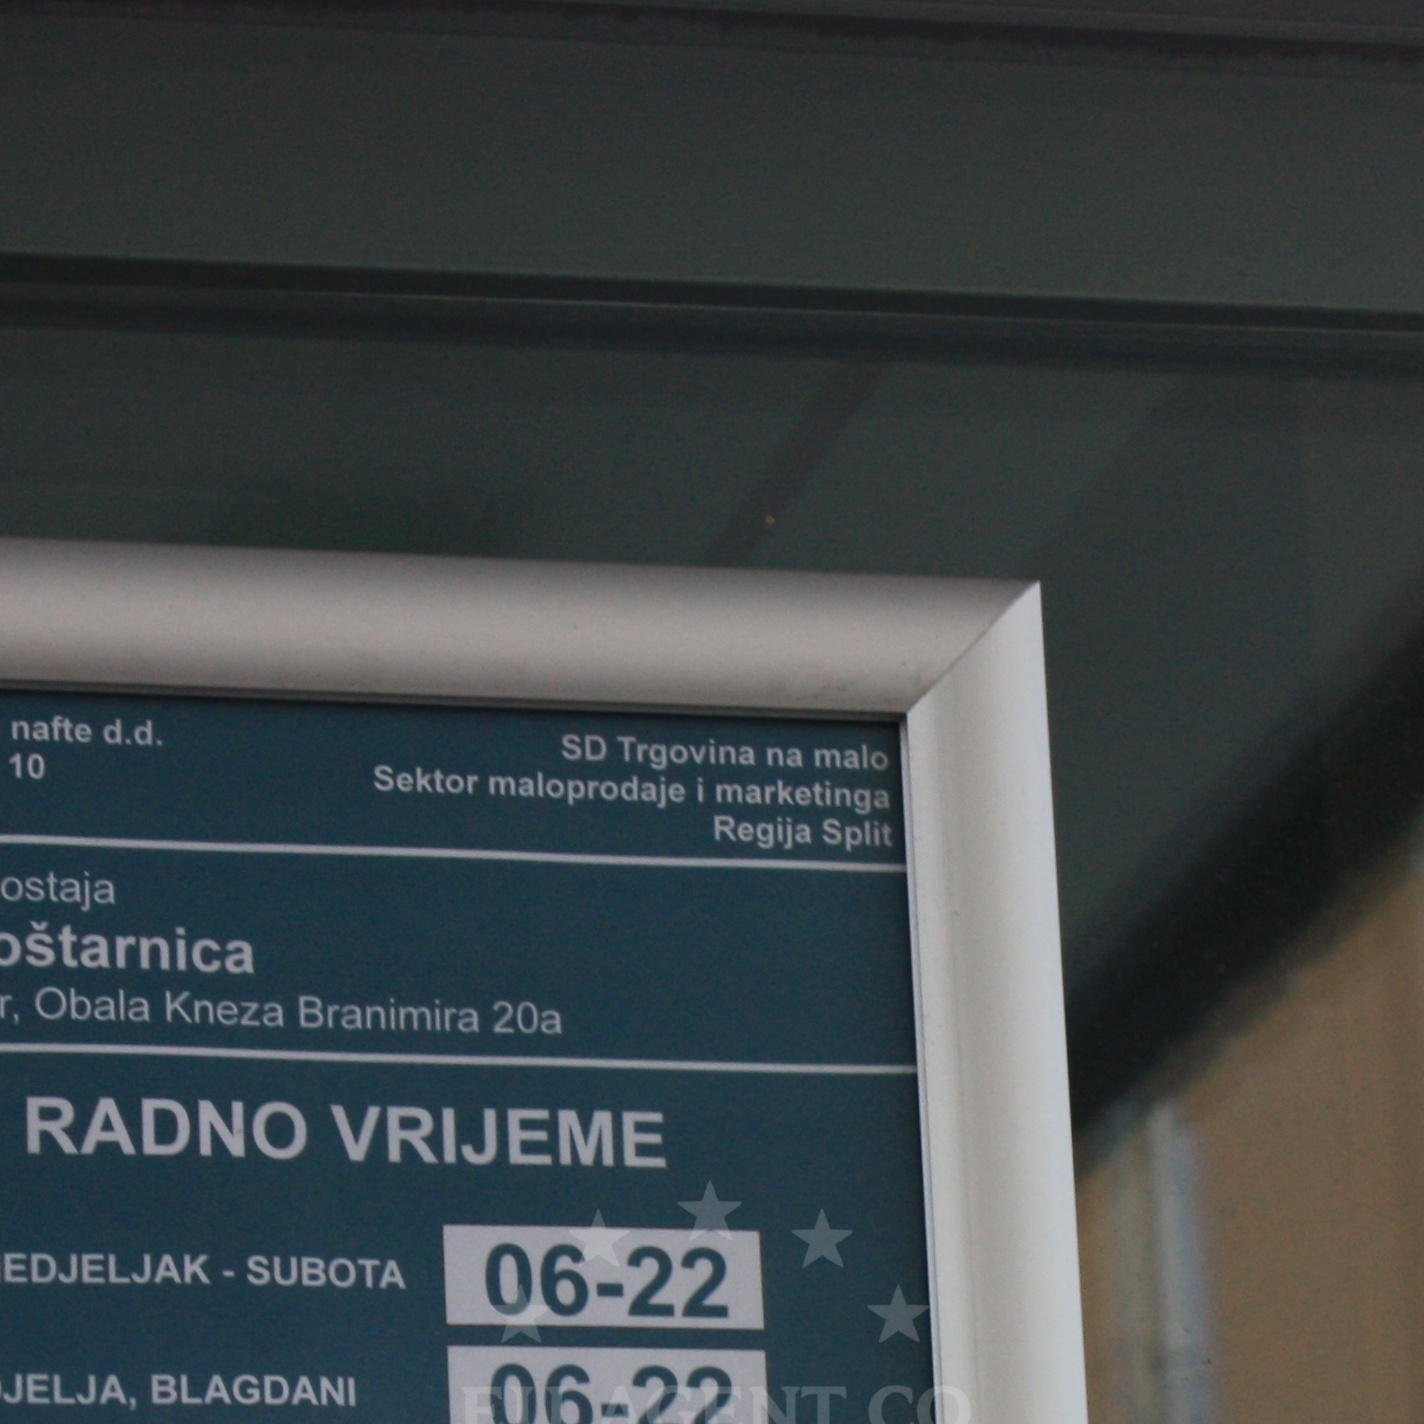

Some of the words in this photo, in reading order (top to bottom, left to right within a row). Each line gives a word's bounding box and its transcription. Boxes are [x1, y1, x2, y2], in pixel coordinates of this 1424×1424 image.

[11, 715, 92, 742] nafte
[103, 720, 163, 746] d.d.
[10, 753, 46, 779] 10
[561, 734, 607, 762] SD
[617, 735, 755, 769] Trgovina
[766, 745, 804, 768] na
[814, 743, 888, 770] malo
[373, 766, 479, 794] Sektor
[488, 772, 686, 808] maloprodaje
[696, 777, 705, 801] i
[715, 778, 891, 812] marketinga
[713, 816, 812, 849] Regija
[822, 819, 894, 850] Split
[35, 986, 151, 1022] Obala
[164, 991, 285, 1027] Kneza
[299, 995, 481, 1034] Branimira
[493, 1002, 562, 1035] 20a
[25, 1096, 308, 1160] RADNO
[331, 1103, 669, 1169] VRIJEME
[246, 1255, 406, 1290] SUBOTA
[484, 1242, 730, 1319] 06-22
[151, 1374, 357, 1408] BLAGDANI
